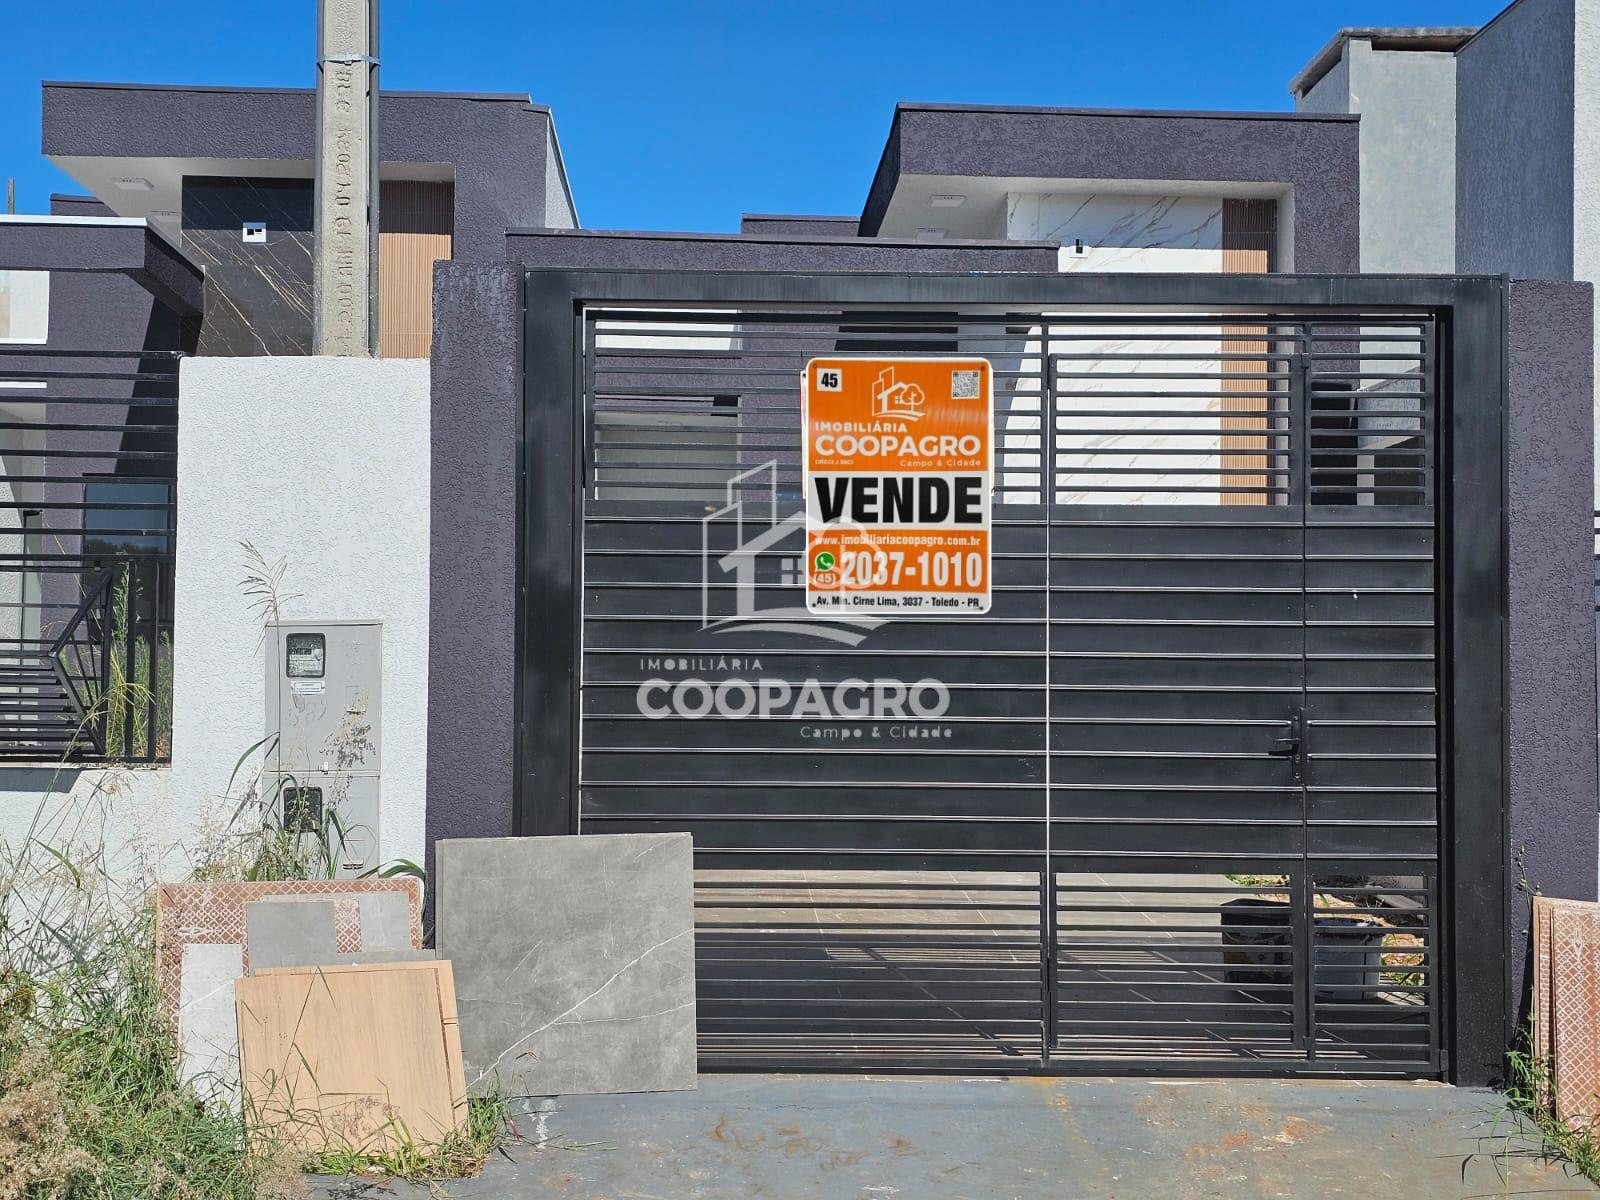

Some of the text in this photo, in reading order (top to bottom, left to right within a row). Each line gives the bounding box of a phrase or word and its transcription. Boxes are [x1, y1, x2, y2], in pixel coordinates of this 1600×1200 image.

[820, 372, 838, 388] 45
[815, 422, 907, 433] IMOBILIÁRIA
[815, 435, 981, 457] COOPAGRO
[900, 459, 933, 468] Campo
[946, 459, 981, 467] Cidade
[814, 476, 982, 523] VENDE
[840, 551, 982, 587] 2037-1010
[816, 596, 829, 605] Av.
[831, 596, 850, 605] Mn.
[853, 596, 875, 606] Cirne
[877, 596, 900, 608] Lima,
[902, 597, 923, 606] 3037
[932, 597, 960, 607] Toledo
[967, 598, 979, 607] PR
